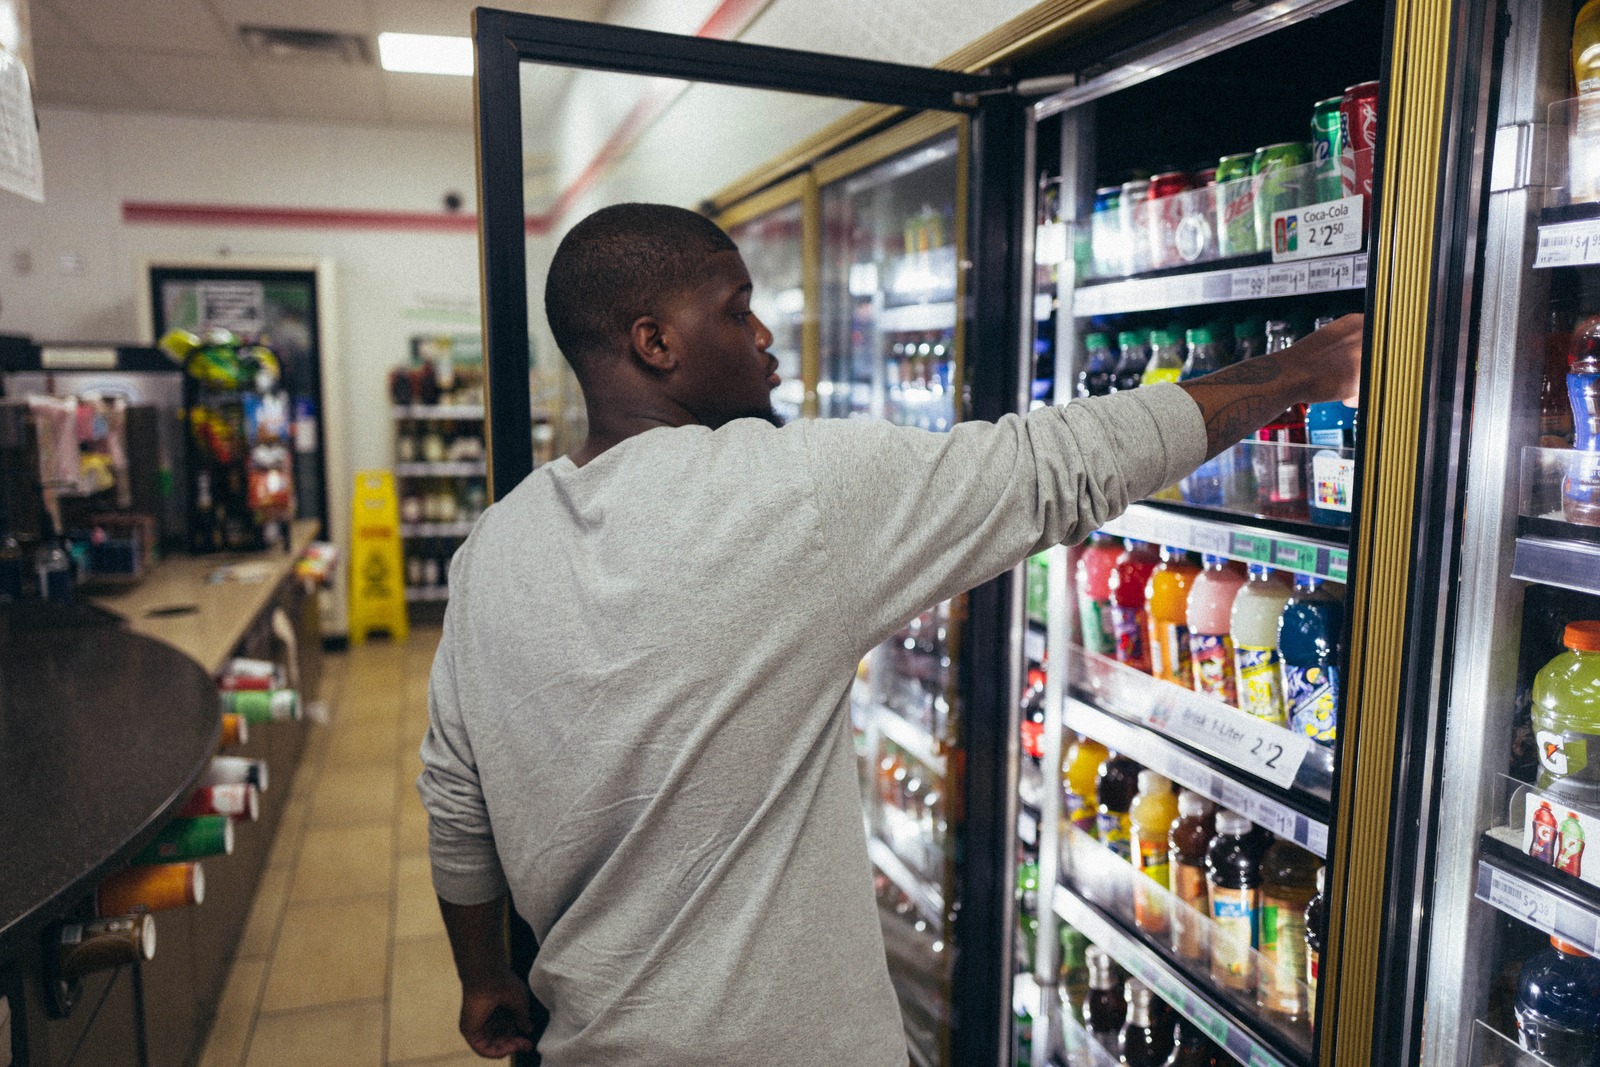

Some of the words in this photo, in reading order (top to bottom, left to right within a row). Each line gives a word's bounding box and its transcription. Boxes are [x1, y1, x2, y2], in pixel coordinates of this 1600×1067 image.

[1303, 203, 1349, 223] Coca-Cola
[1309, 228, 1316, 243] 2
[1212, 719, 1244, 742] 1-Liter
[1251, 737, 1263, 754] 2
[1537, 731, 1568, 775] G
